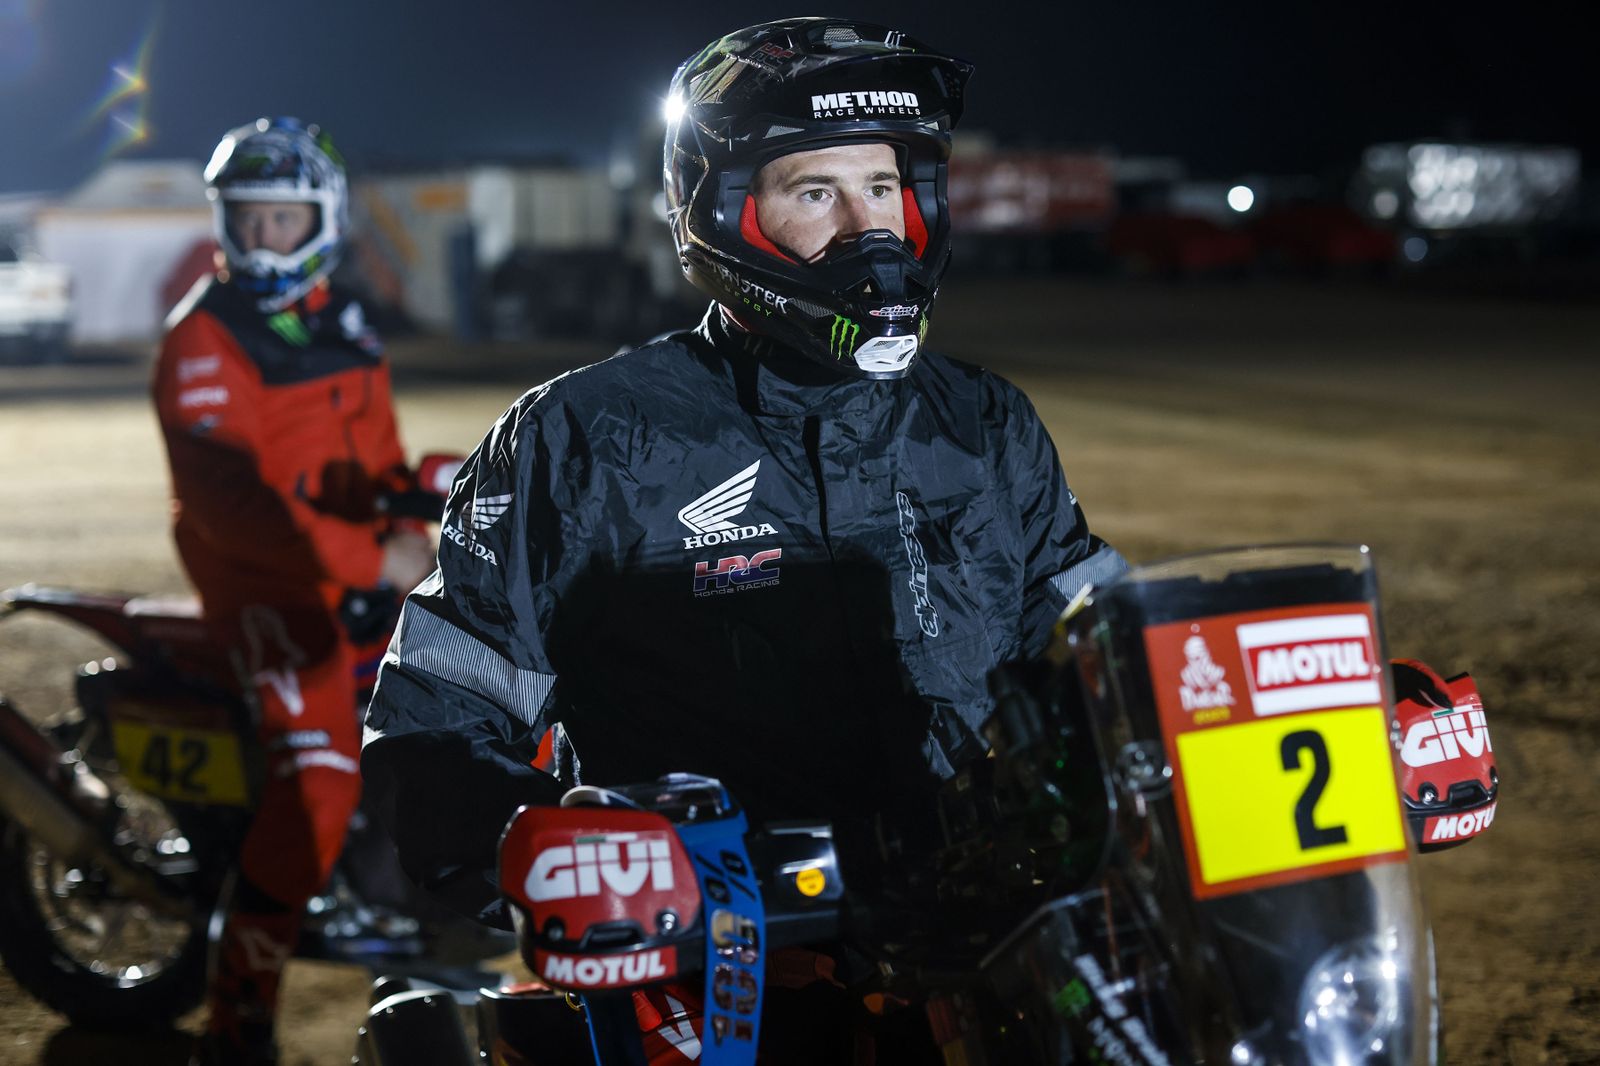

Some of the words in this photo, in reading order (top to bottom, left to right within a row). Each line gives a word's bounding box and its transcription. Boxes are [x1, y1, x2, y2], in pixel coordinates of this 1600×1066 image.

[811, 91, 919, 111] METHOD
[814, 108, 855, 119] RACE
[863, 107, 921, 116] WHEELS
[683, 523, 779, 550] HONDA
[693, 548, 782, 592] HRC
[694, 588, 735, 598] Honda
[736, 578, 780, 592] RACING
[1257, 641, 1370, 688] MOTUL
[1401, 710, 1493, 768] GIVI
[141, 735, 209, 794] 42
[1280, 729, 1348, 851] 2
[1431, 801, 1498, 840] MOTU
[524, 839, 675, 903] GIVI
[544, 951, 667, 986] MOTUL
